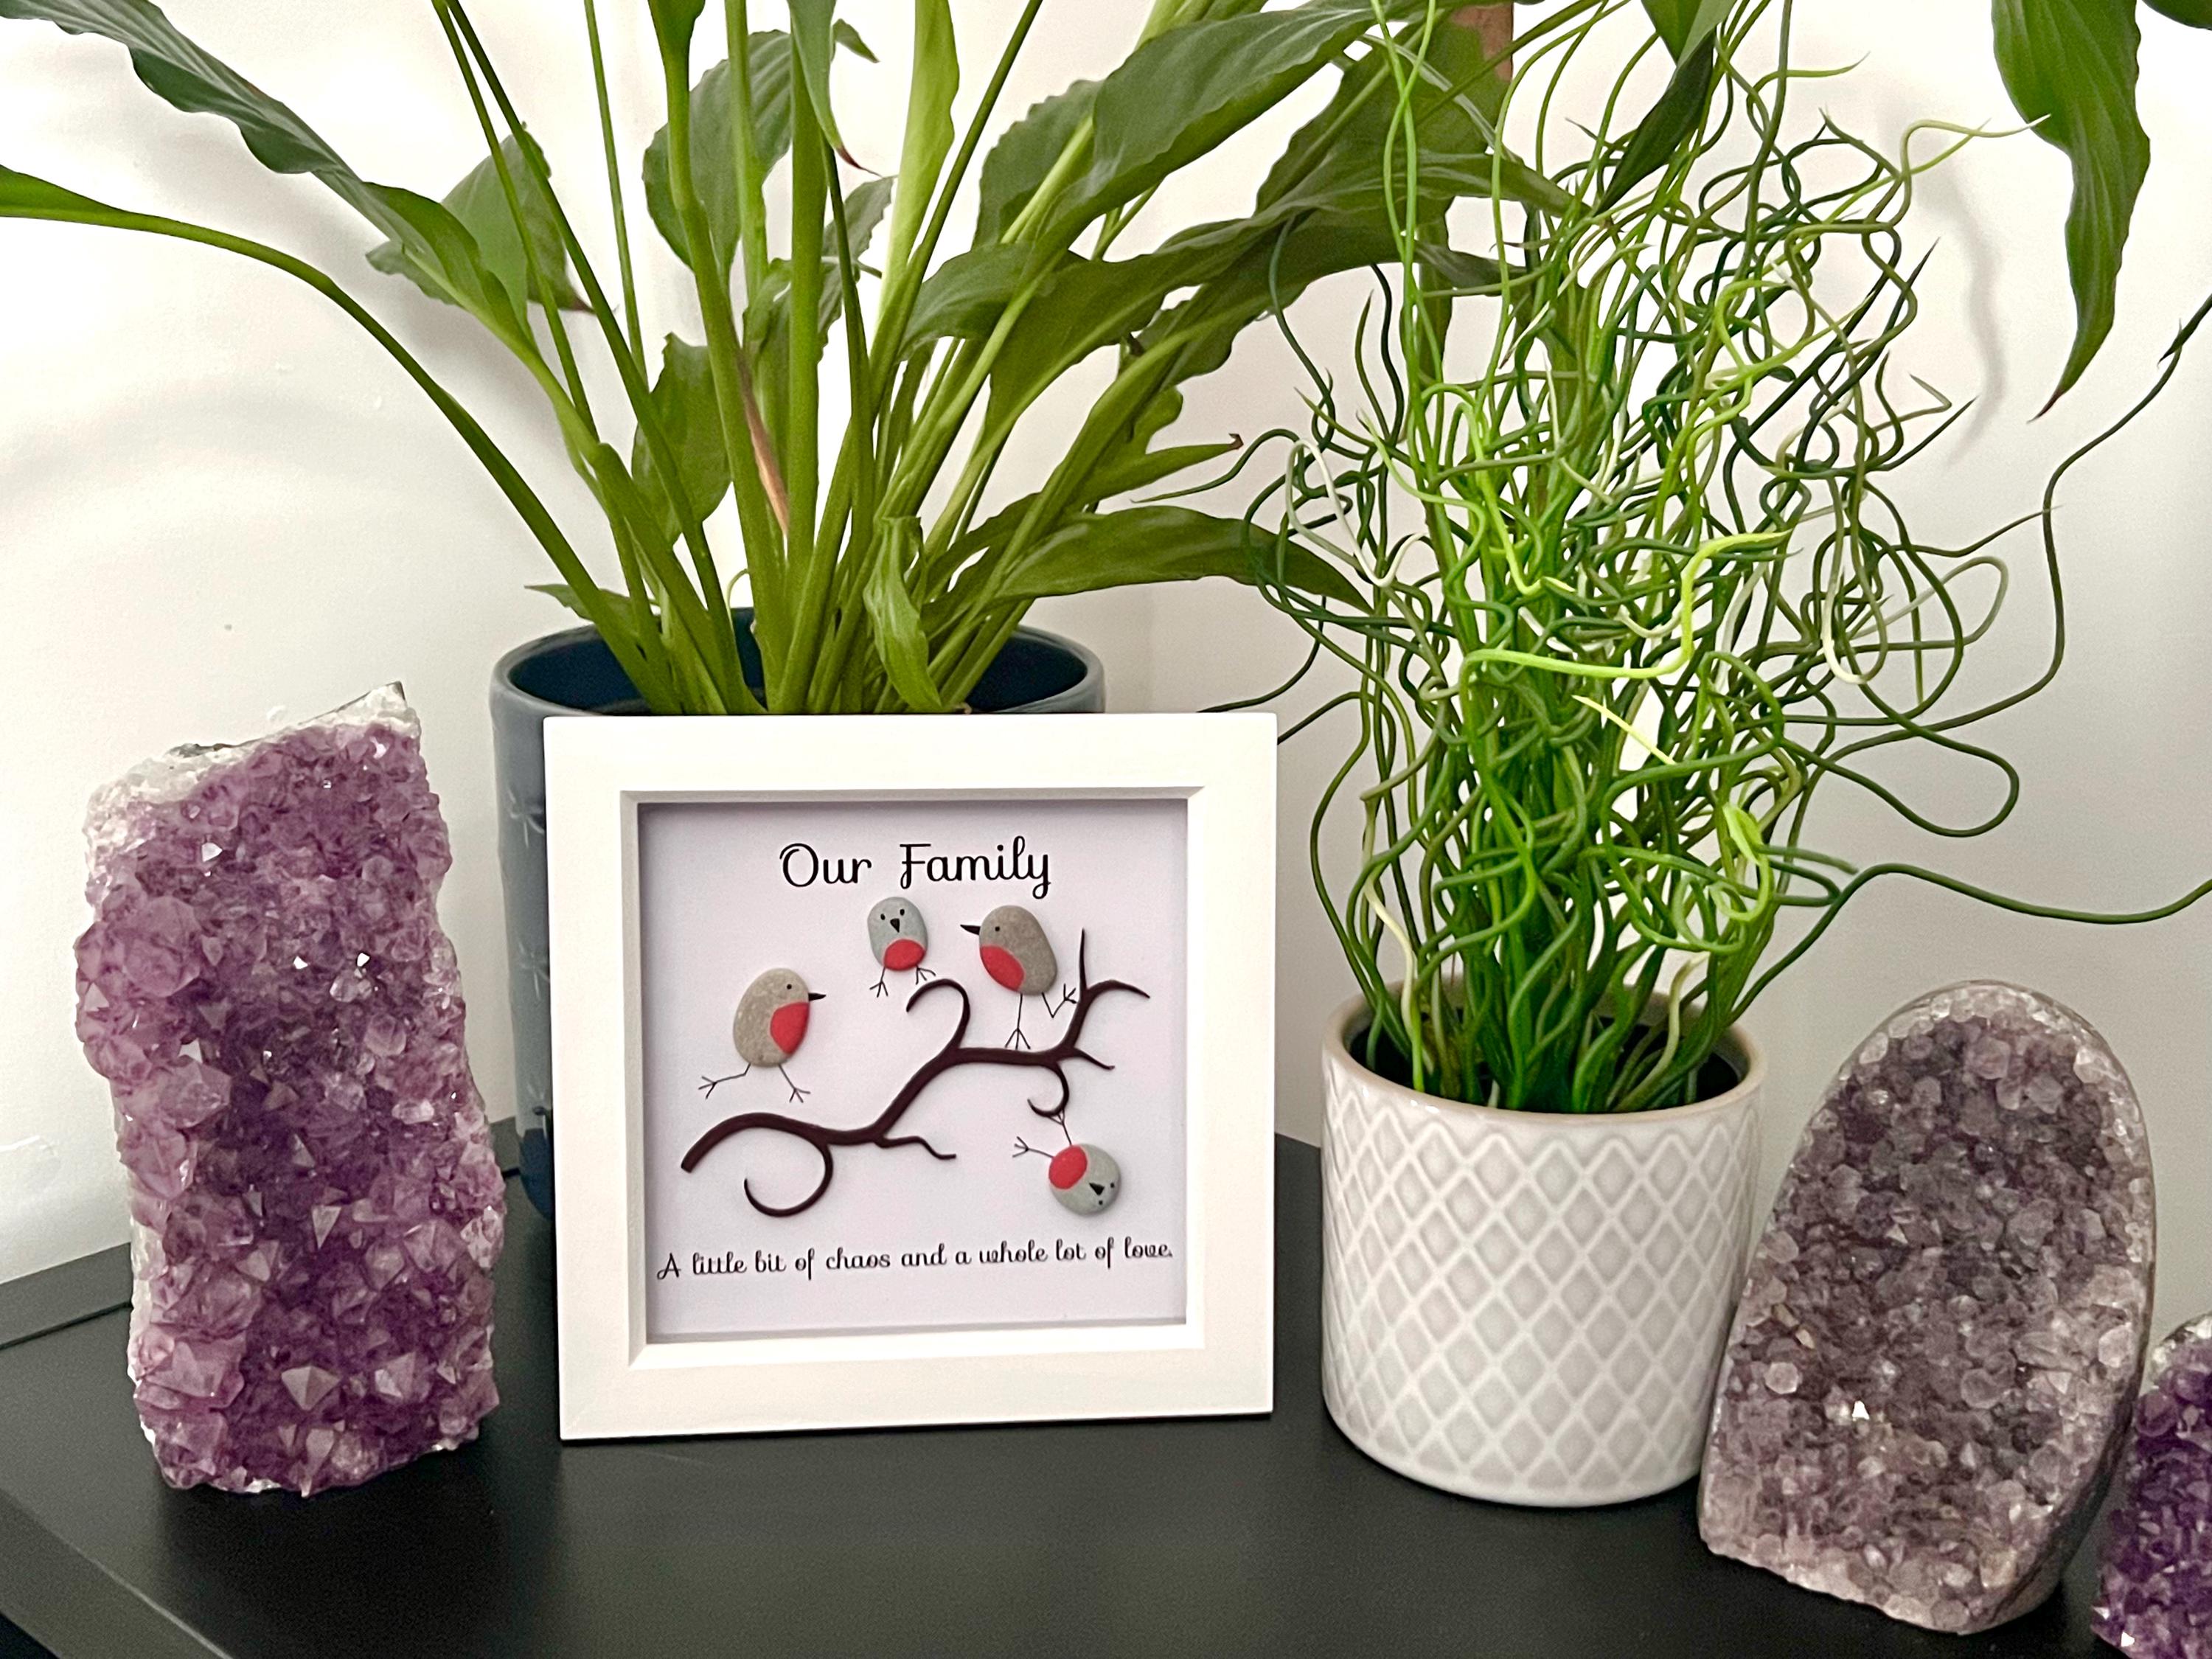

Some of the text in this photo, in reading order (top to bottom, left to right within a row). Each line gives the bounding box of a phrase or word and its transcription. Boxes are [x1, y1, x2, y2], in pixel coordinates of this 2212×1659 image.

[779, 835, 1051, 900] Our Family
[656, 1236, 1173, 1281] A little bit of chaos and a whole lot of love.
